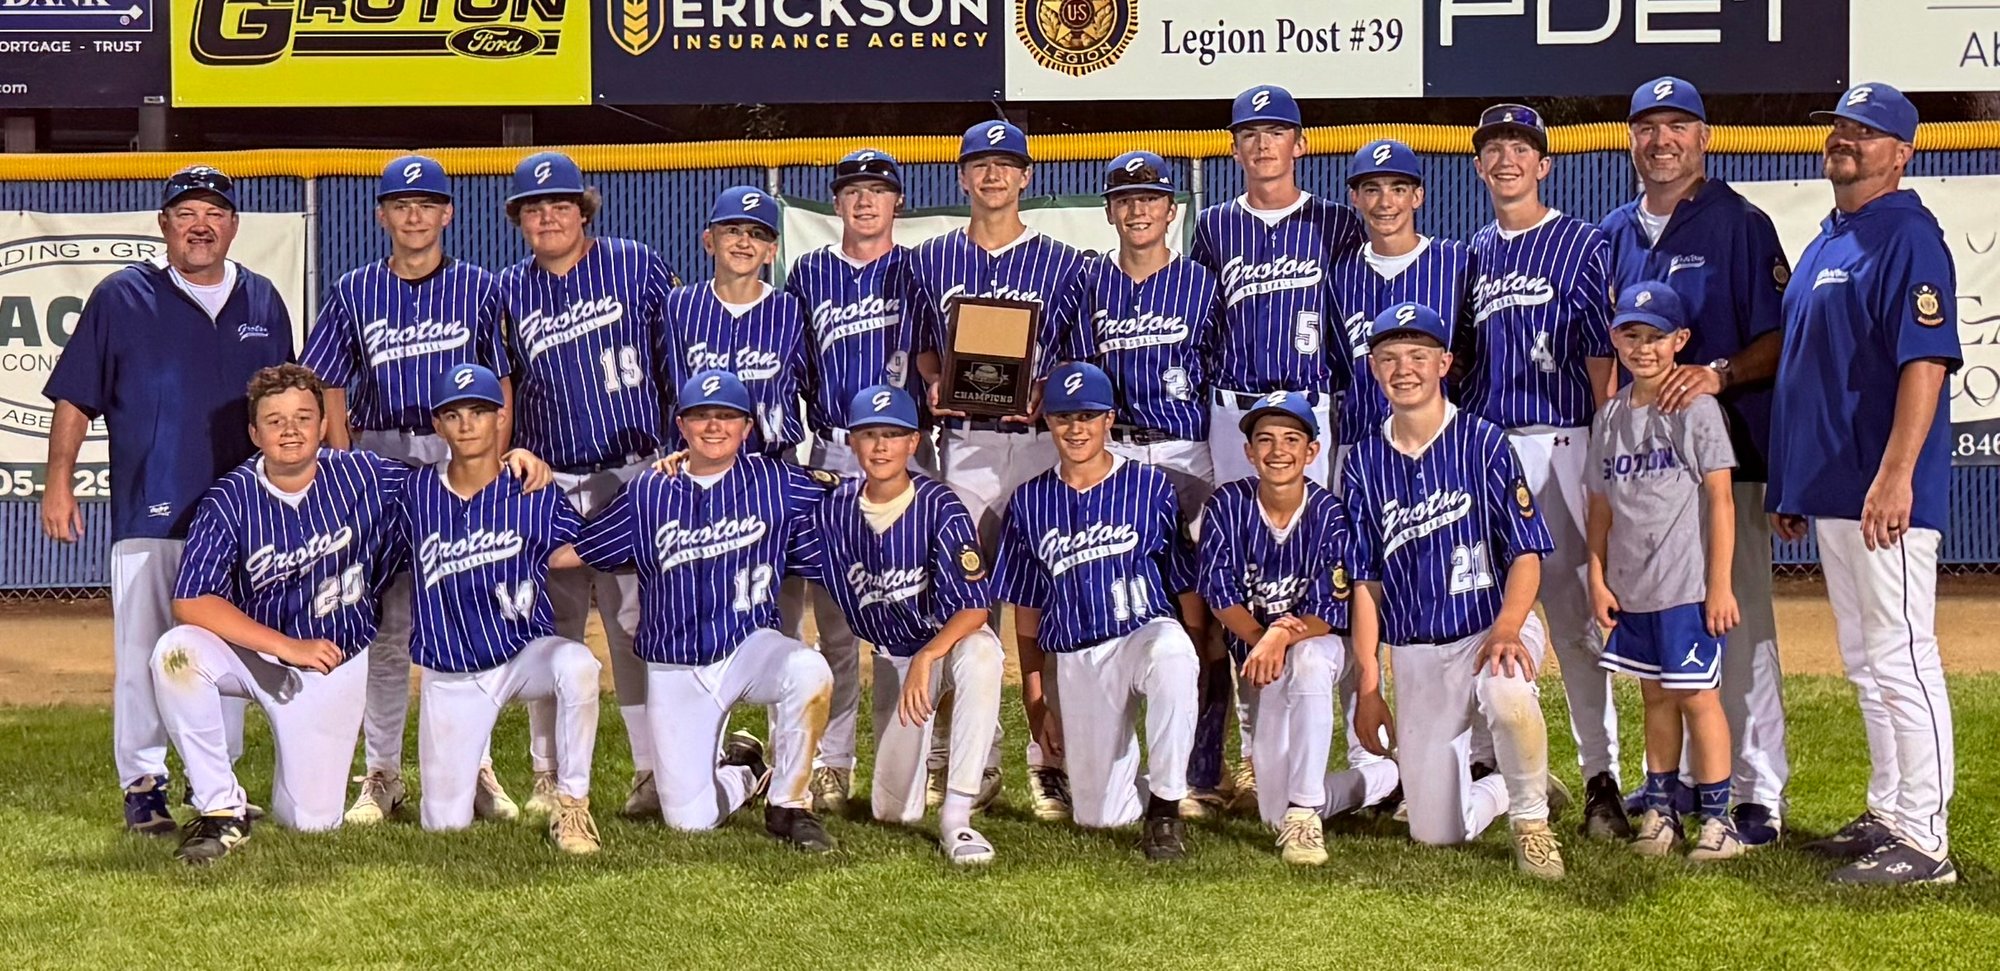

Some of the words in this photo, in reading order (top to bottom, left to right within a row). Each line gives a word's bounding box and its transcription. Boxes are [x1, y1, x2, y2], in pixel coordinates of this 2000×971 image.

[673, 0, 988, 28] ERICKSON
[93, 40, 143, 52] TRUST
[467, 29, 522, 52] Ford
[673, 33, 849, 50] INSURANCE
[867, 32, 988, 48] AGENCY
[1042, 42, 1113, 64] LEGION
[1161, 19, 1267, 66] Legion
[1276, 18, 1341, 53] Post
[1350, 18, 1404, 52] #39
[0, 242, 80, 267] DING
[1221, 254, 1322, 300] Groton
[363, 318, 471, 353] Groton
[519, 295, 623, 350] Groton
[812, 294, 900, 341] Groton
[1294, 310, 1321, 354] 5
[3, 353, 58, 372] CON
[600, 345, 644, 394] 19
[1530, 331, 1557, 373] 4
[954, 390, 1014, 404] CHAMPIONS
[1162, 366, 1191, 401] 2
[1603, 445, 1676, 480] GOTON
[1382, 487, 1472, 543] Groton
[245, 526, 353, 586] Groto
[420, 527, 523, 575] Groton
[655, 514, 767, 563] Groton
[1038, 520, 1139, 568] Groton
[314, 562, 366, 619] 20
[733, 563, 774, 613] 12
[1450, 540, 1495, 596] 21
